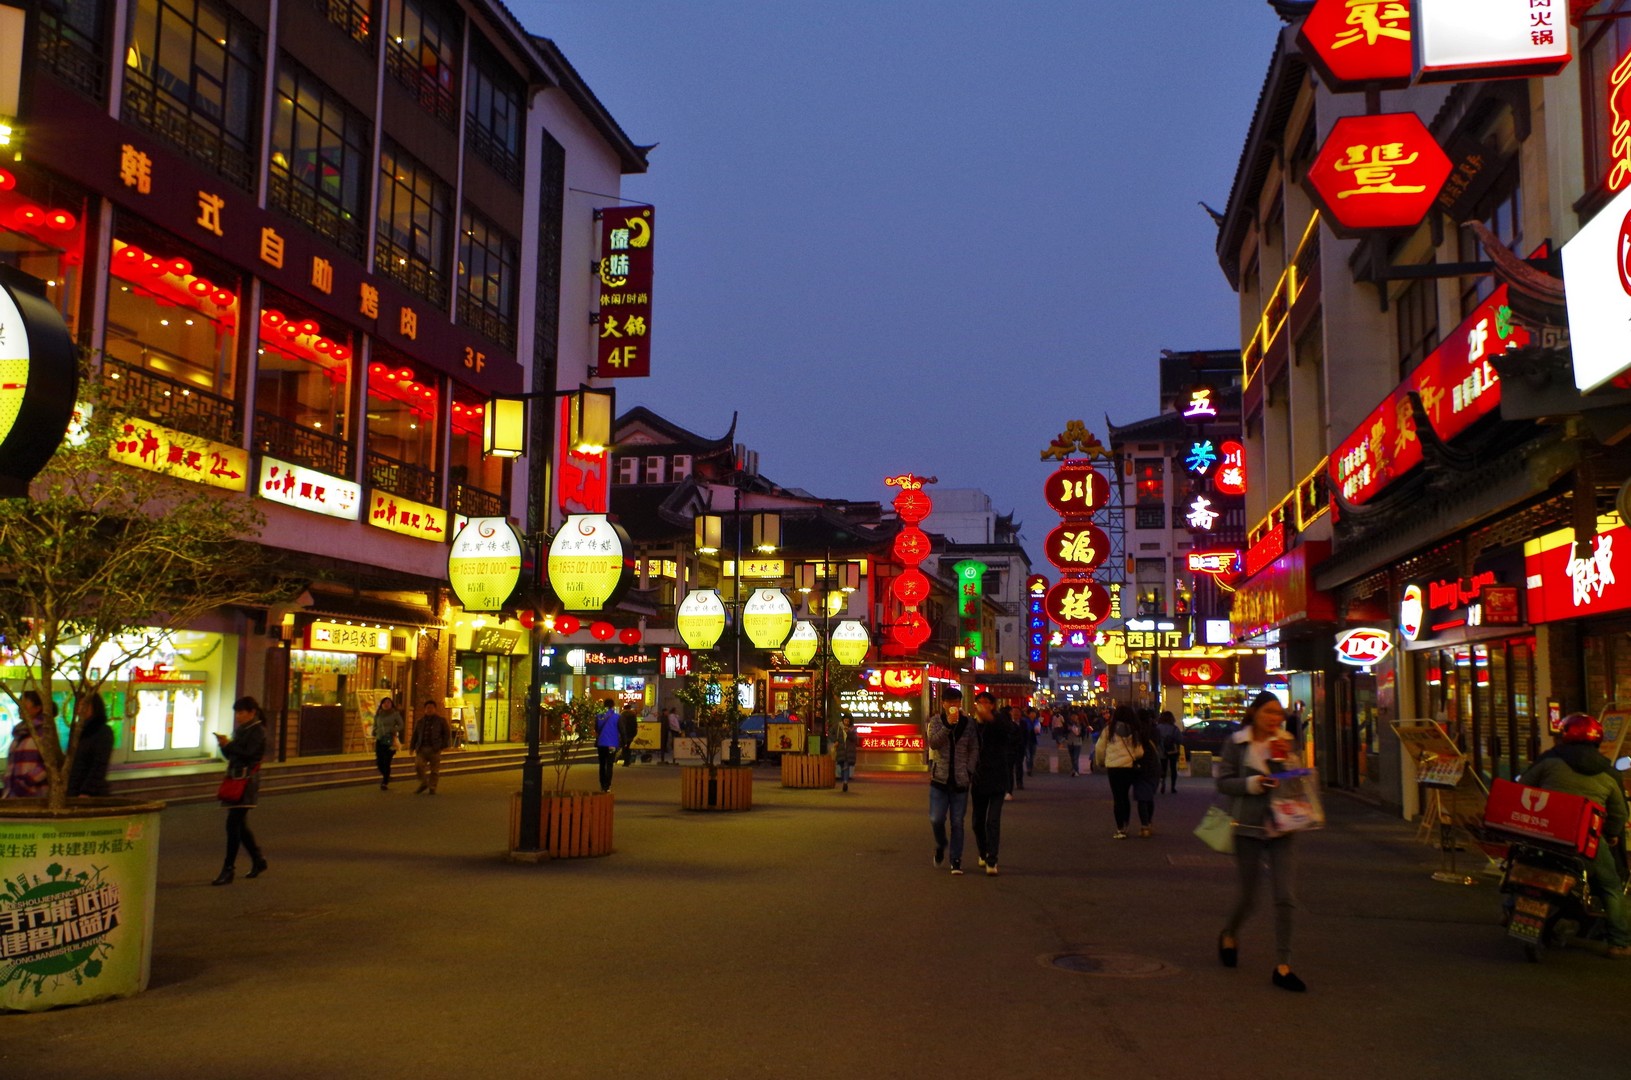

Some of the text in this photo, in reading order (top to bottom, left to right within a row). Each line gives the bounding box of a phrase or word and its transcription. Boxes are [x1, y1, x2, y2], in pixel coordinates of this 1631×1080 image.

[120, 144, 486, 374] 韩式自助烤肉 3F
[600, 293, 648, 306] 休闲/时尚
[600, 315, 647, 338] 火锅
[608, 346, 637, 368] 4F
[1184, 390, 1220, 530] 五芳斋
[1347, 637, 1383, 657] DQ
[618, 655, 648, 665] MODERN
[862, 738, 920, 748] 关注未成年人成
